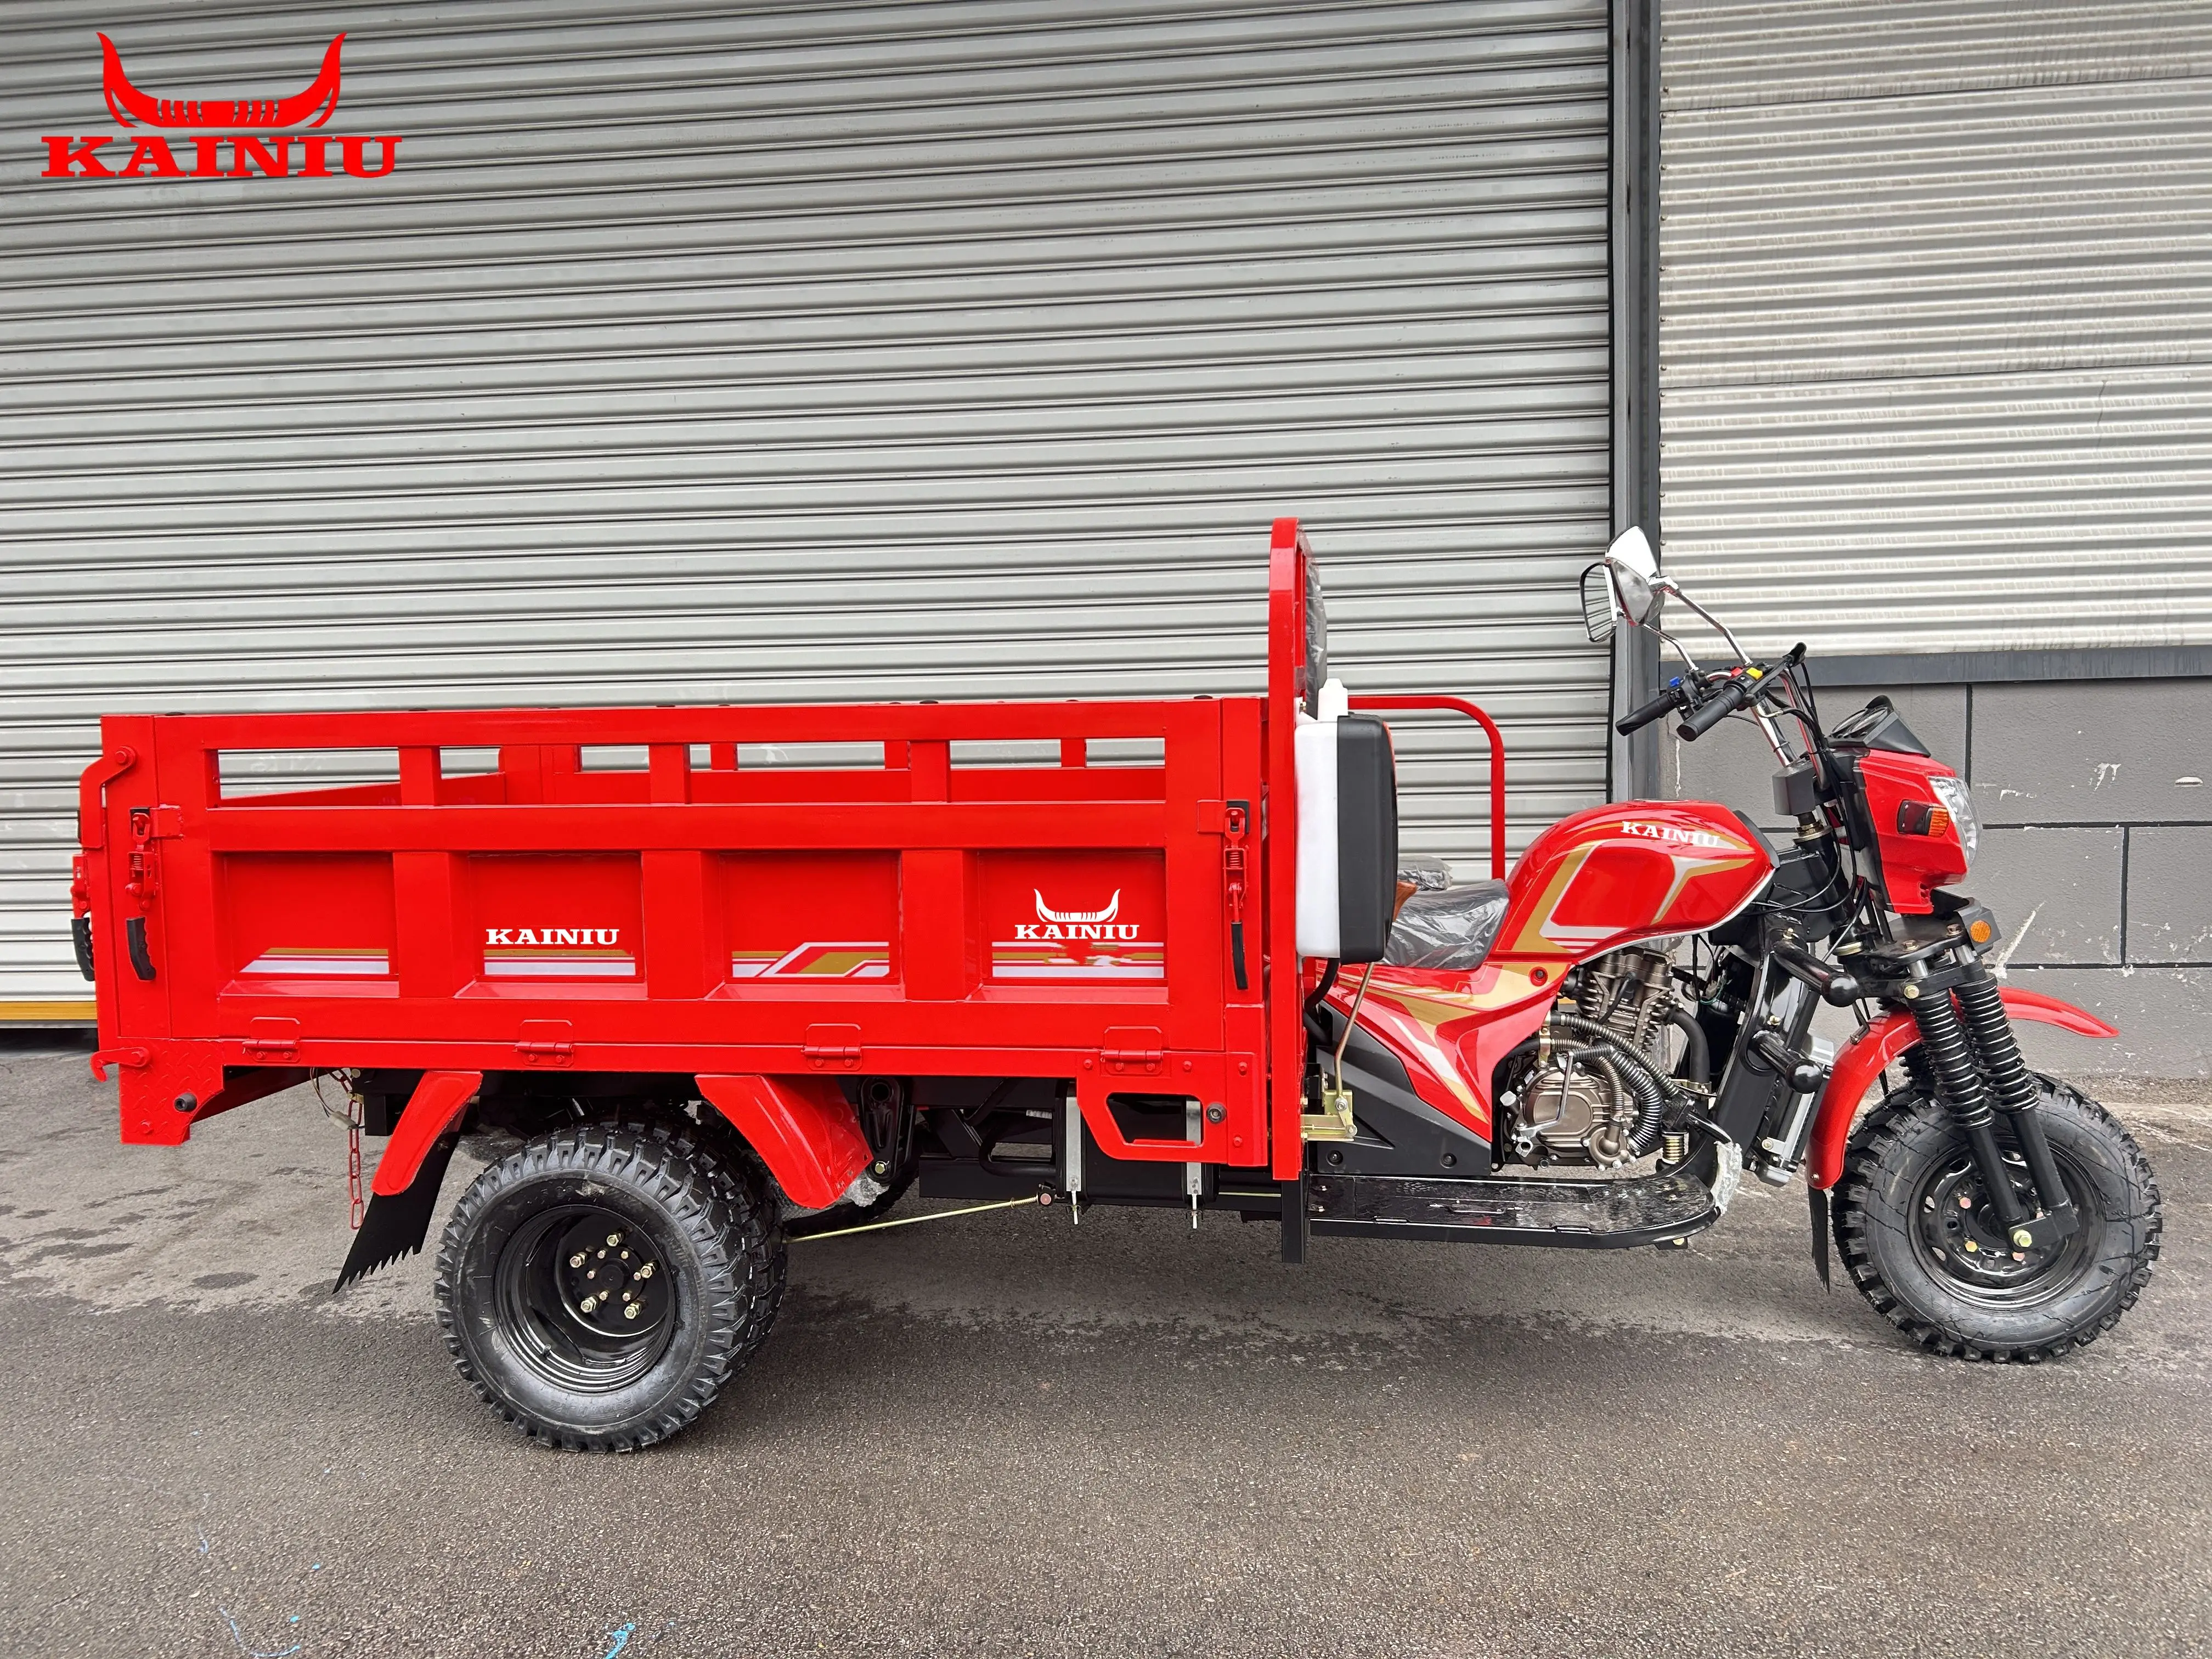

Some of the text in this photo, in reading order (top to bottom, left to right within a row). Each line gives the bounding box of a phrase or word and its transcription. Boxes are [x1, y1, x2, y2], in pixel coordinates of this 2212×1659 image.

[1620, 821, 1720, 846] KAINIU
[486, 929, 619, 945] KAINIU
[1014, 924, 1139, 940] KAINIU
